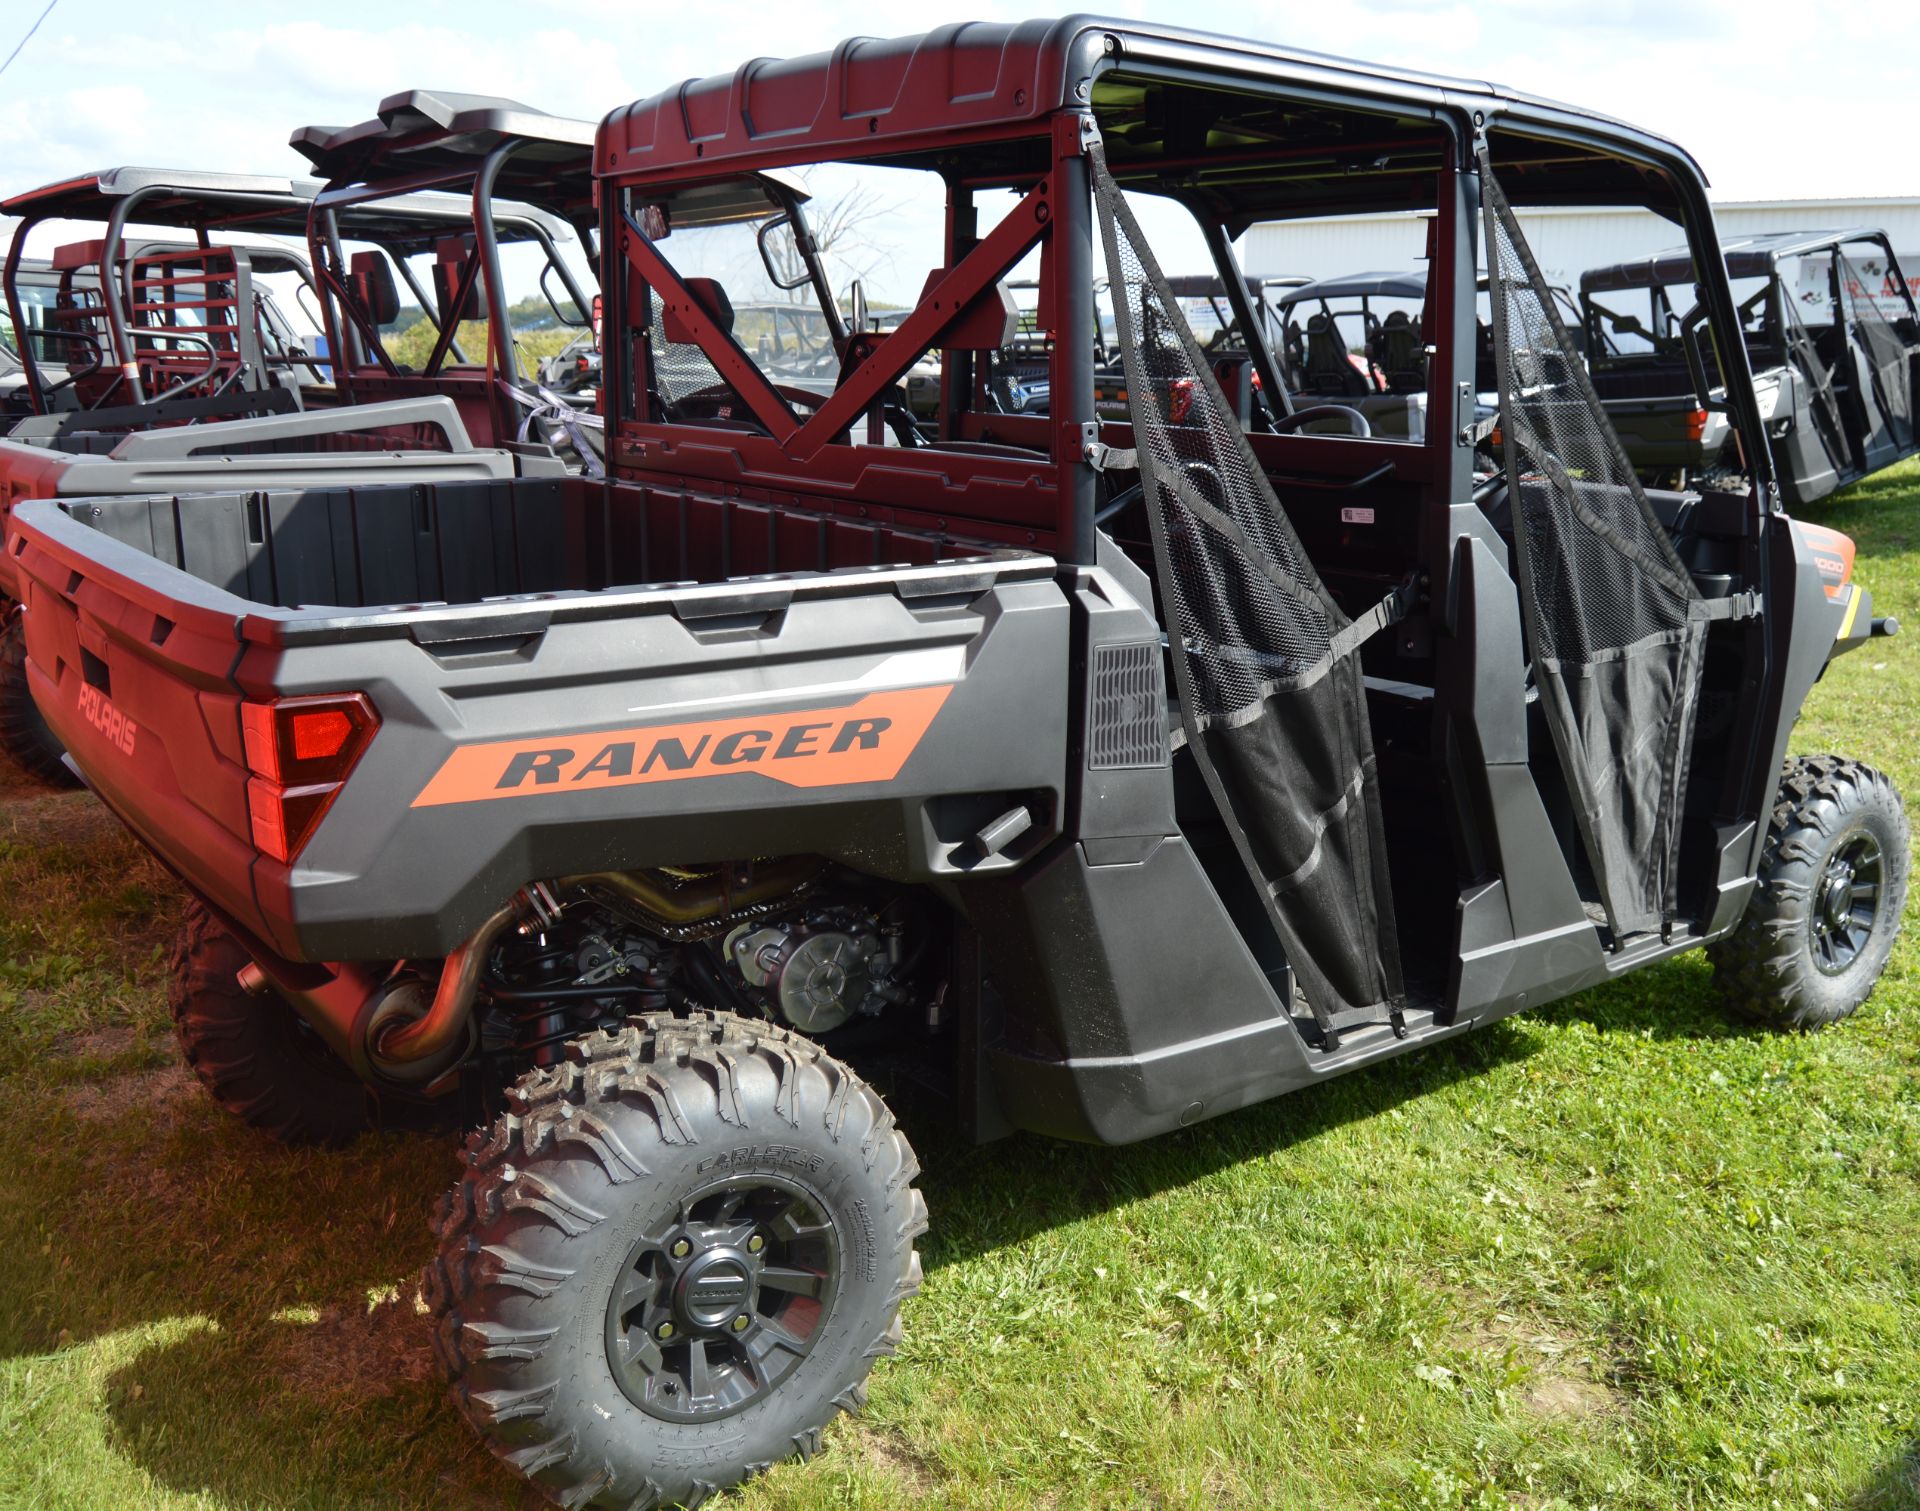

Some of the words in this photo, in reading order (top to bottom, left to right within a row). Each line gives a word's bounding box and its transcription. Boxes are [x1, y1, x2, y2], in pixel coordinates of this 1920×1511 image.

[77, 680, 137, 757] POLARIS
[494, 716, 892, 789] RANGER
[696, 1144, 825, 1175] CARLSTAR
